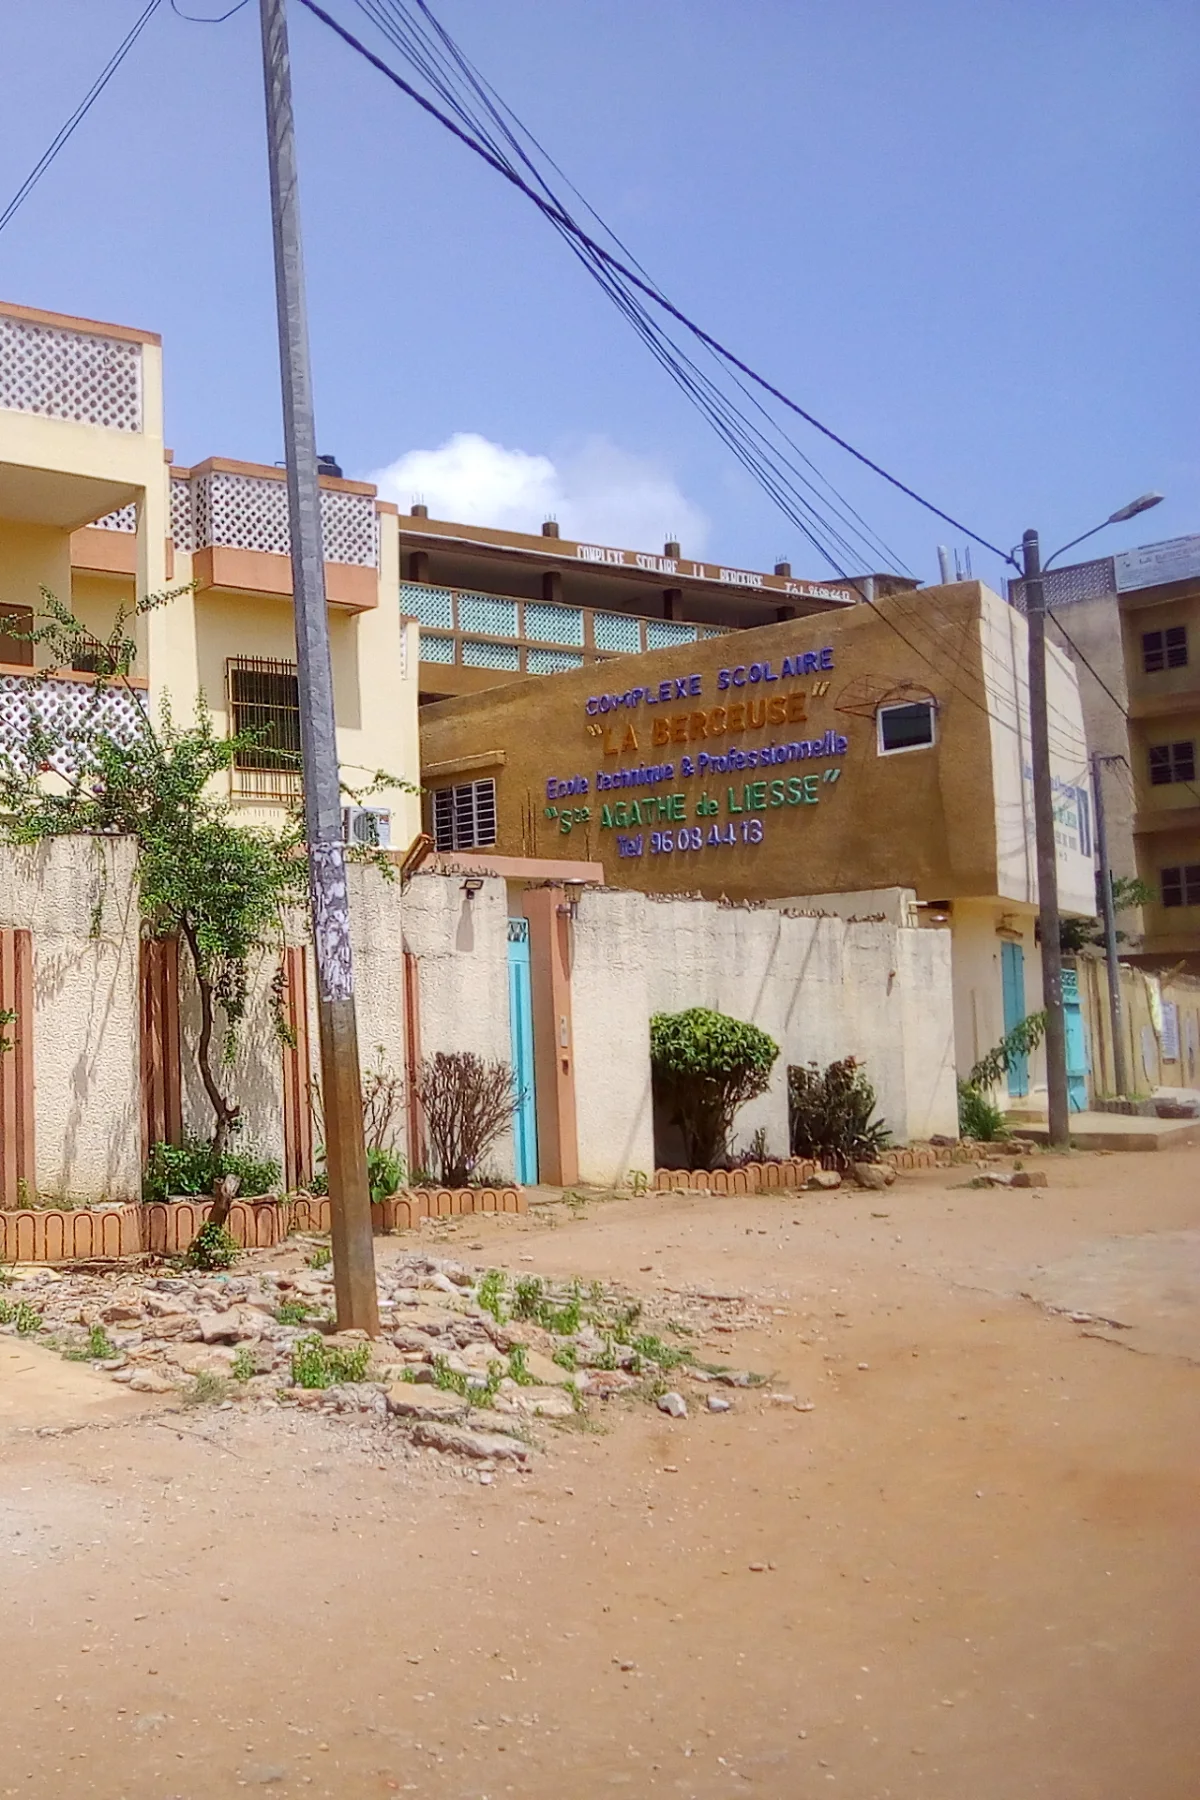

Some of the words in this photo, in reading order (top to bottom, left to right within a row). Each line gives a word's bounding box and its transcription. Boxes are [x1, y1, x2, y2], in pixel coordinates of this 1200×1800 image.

[585, 674, 702, 716] COMPLEXE
[717, 646, 835, 690] SCOLAIRE
[546, 774, 589, 799] Ecole
[681, 755, 695, 777] &
[699, 729, 848, 775] Professionnelle
[601, 794, 687, 828] AGATHE
[696, 791, 719, 816] de
[617, 833, 644, 858] Tel
